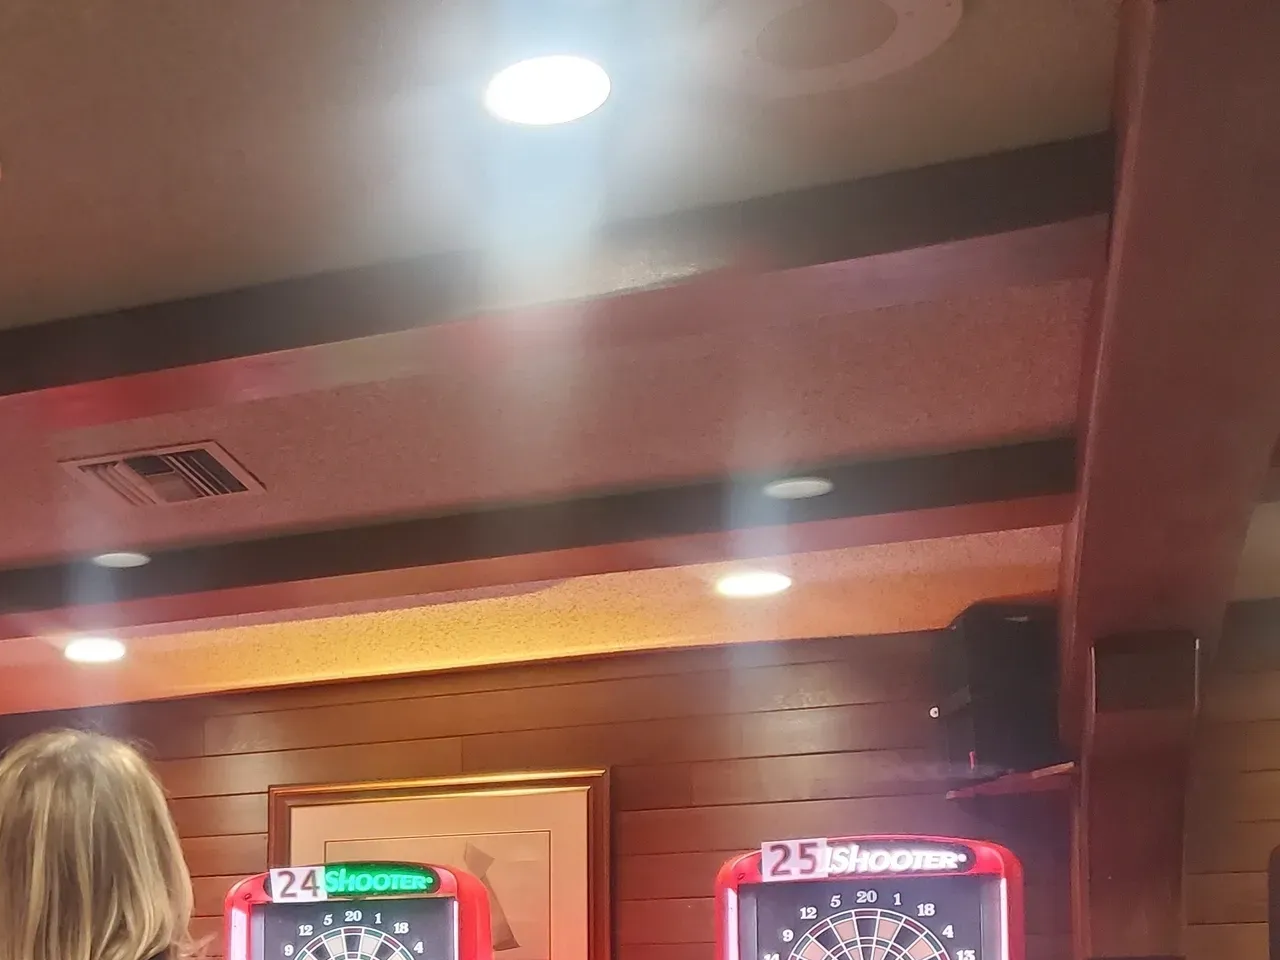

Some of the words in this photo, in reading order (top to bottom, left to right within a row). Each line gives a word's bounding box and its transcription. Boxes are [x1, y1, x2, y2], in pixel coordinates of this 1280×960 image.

[770, 843, 817, 876] 25
[277, 870, 320, 898] 24
[831, 894, 841, 907] 5
[856, 890, 878, 903] 20
[893, 893, 902, 905] 1
[345, 910, 362, 922] 20
[800, 907, 817, 920] 12
[917, 903, 935, 917] 18
[323, 914, 333, 925] 5
[374, 913, 382, 924] 1
[298, 925, 313, 936] 12
[393, 922, 409, 934] 18
[942, 925, 954, 938] 4
[782, 929, 794, 942] 9
[284, 945, 294, 956] 9
[414, 942, 423, 953] 4
